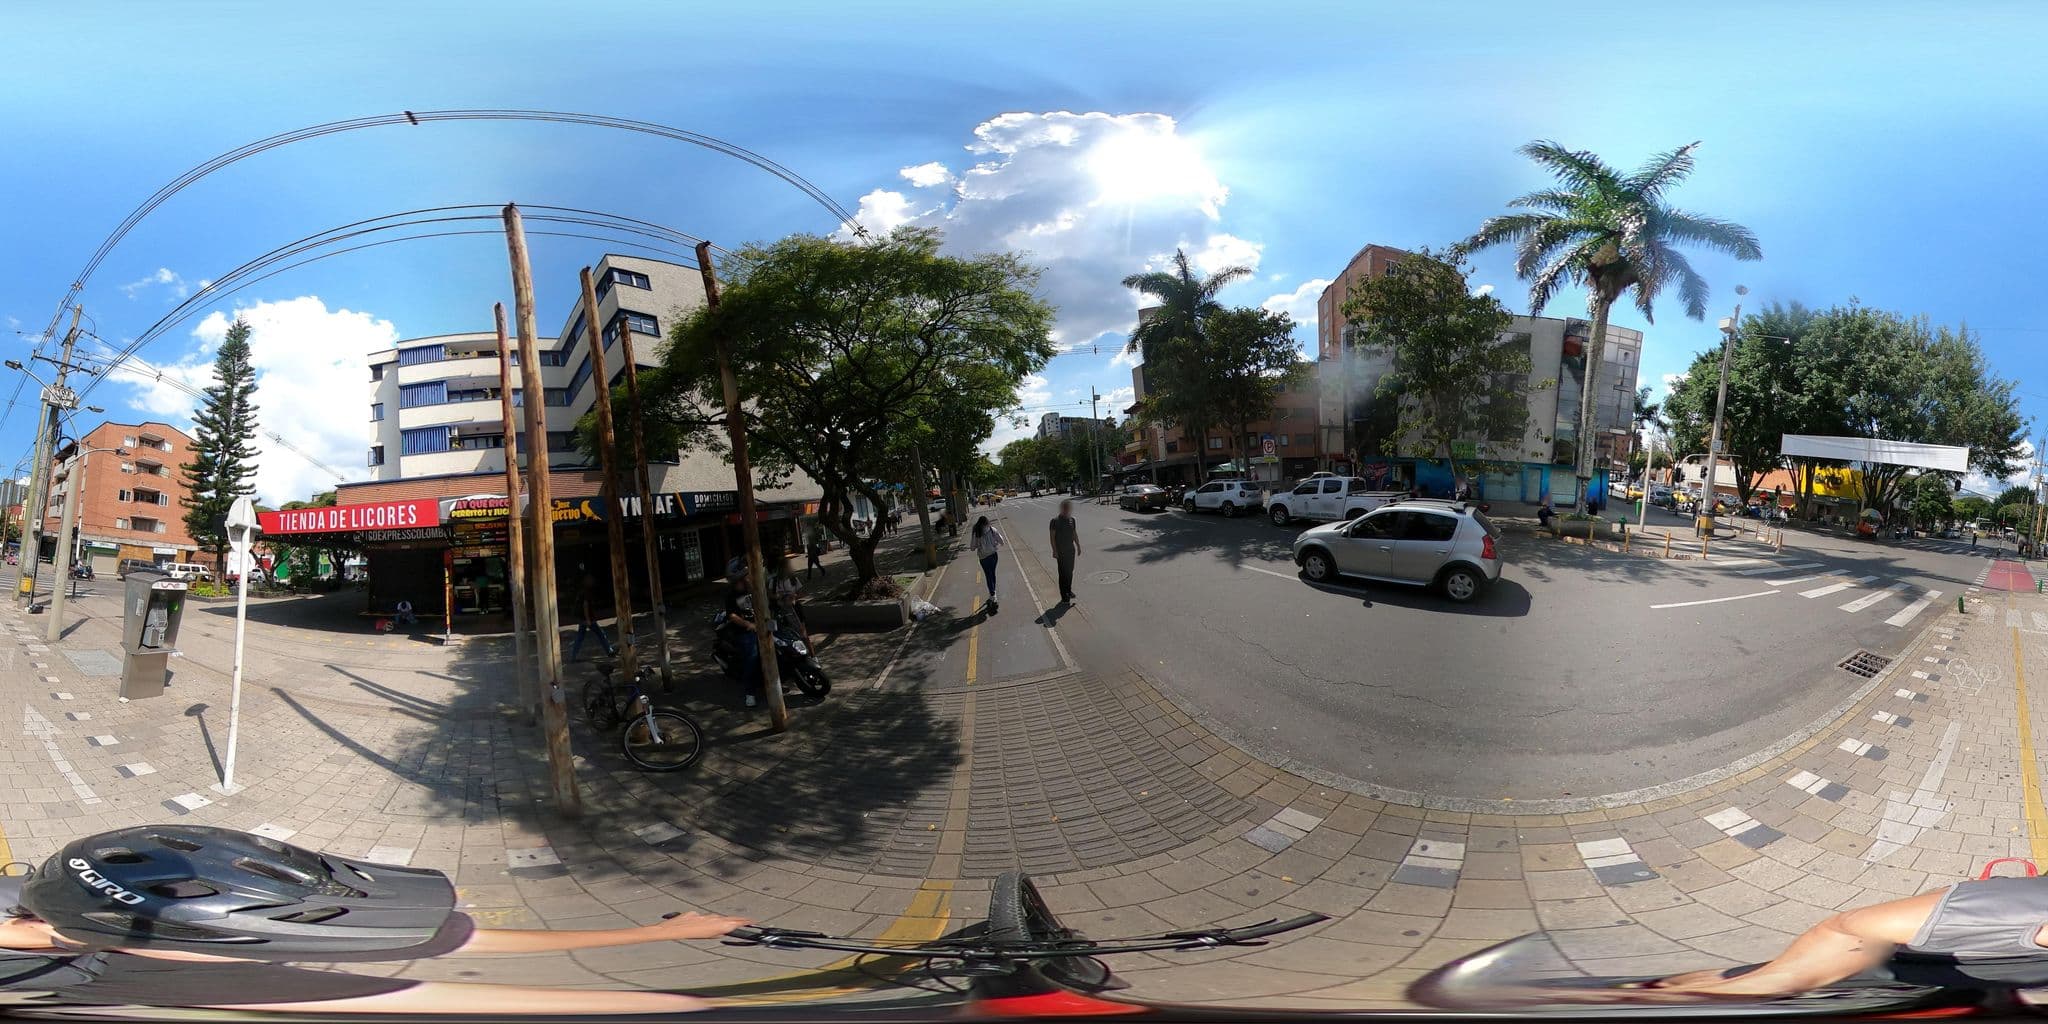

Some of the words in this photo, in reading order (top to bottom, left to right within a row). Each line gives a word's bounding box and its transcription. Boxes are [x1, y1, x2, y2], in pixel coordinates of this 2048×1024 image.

[456, 500, 468, 509] AY
[469, 499, 488, 509] QUE
[279, 511, 326, 531] TIENDA
[329, 509, 347, 529] DE
[351, 504, 417, 528] LICORES
[451, 508, 487, 518] PERRITOS
[551, 508, 581, 521] uervo
[79, 869, 146, 905] GIRO
